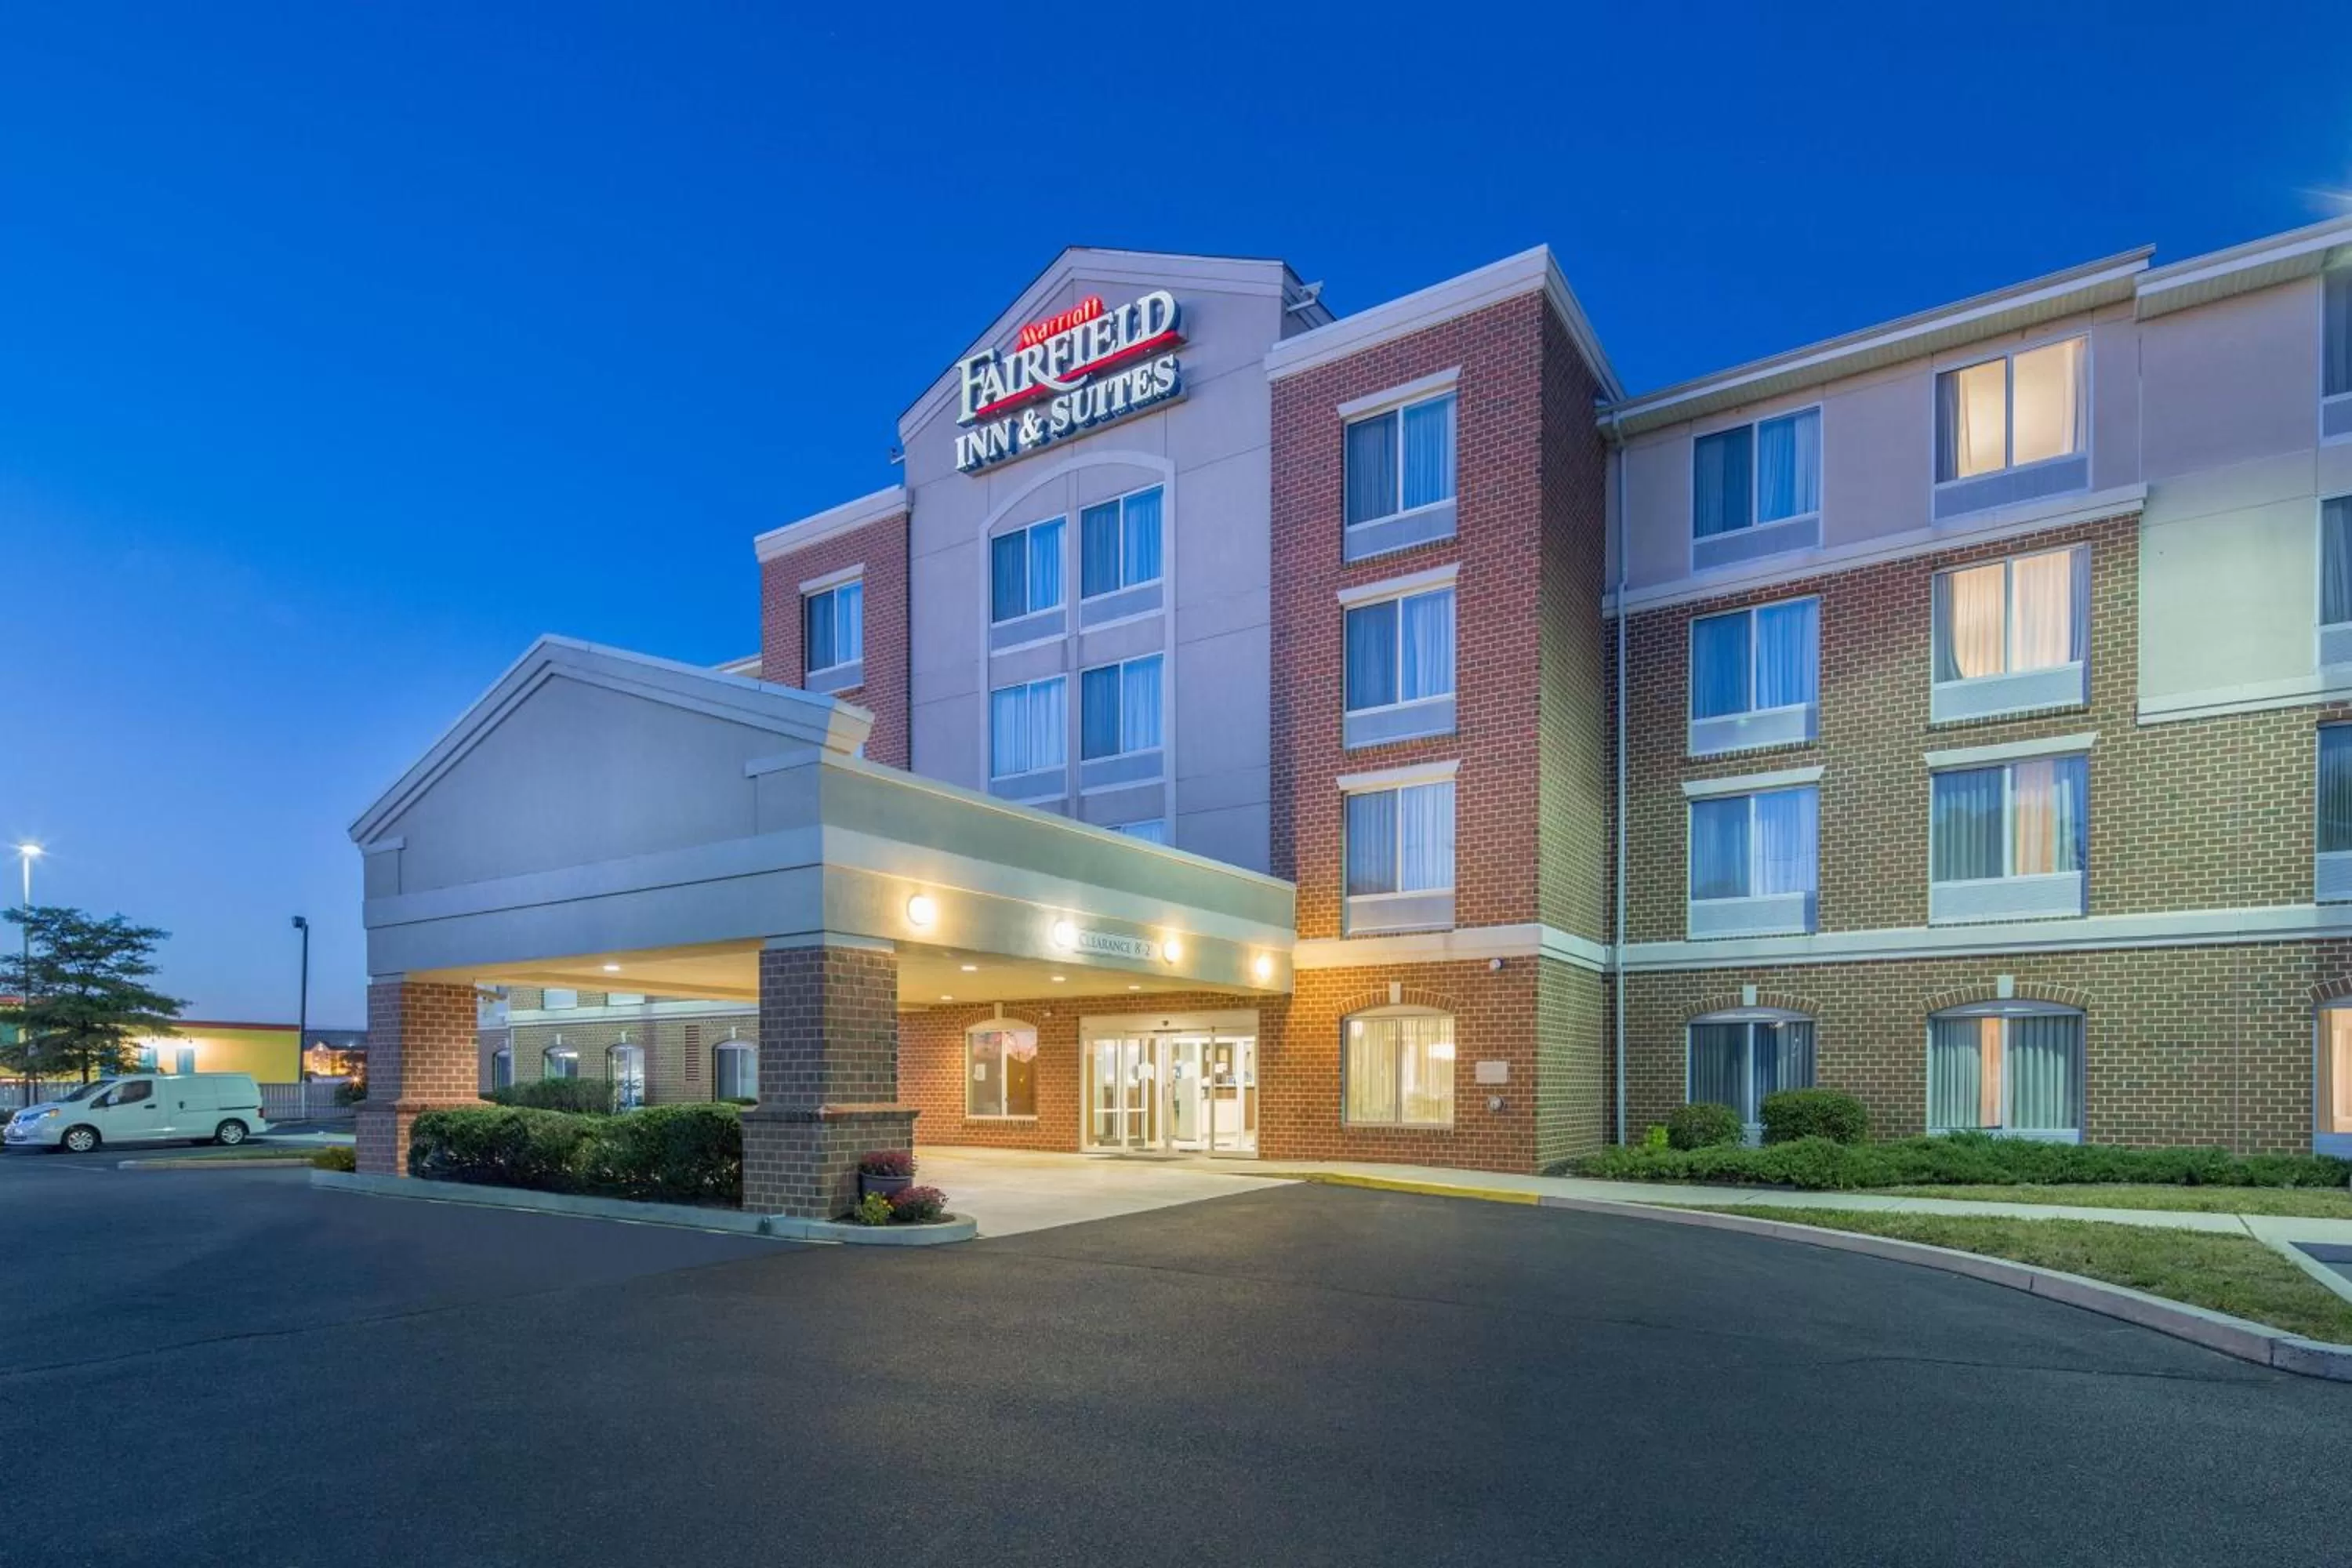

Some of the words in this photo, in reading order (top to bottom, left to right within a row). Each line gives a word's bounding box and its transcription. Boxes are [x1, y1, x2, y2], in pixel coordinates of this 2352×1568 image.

[956, 290, 1176, 424] FAIRFIELD
[1021, 297, 1098, 344] Marriott
[954, 419, 1013, 469] INN
[1019, 408, 1044, 447] &
[1051, 354, 1176, 432] SUITES
[1079, 933, 1131, 954] CLEARANCE
